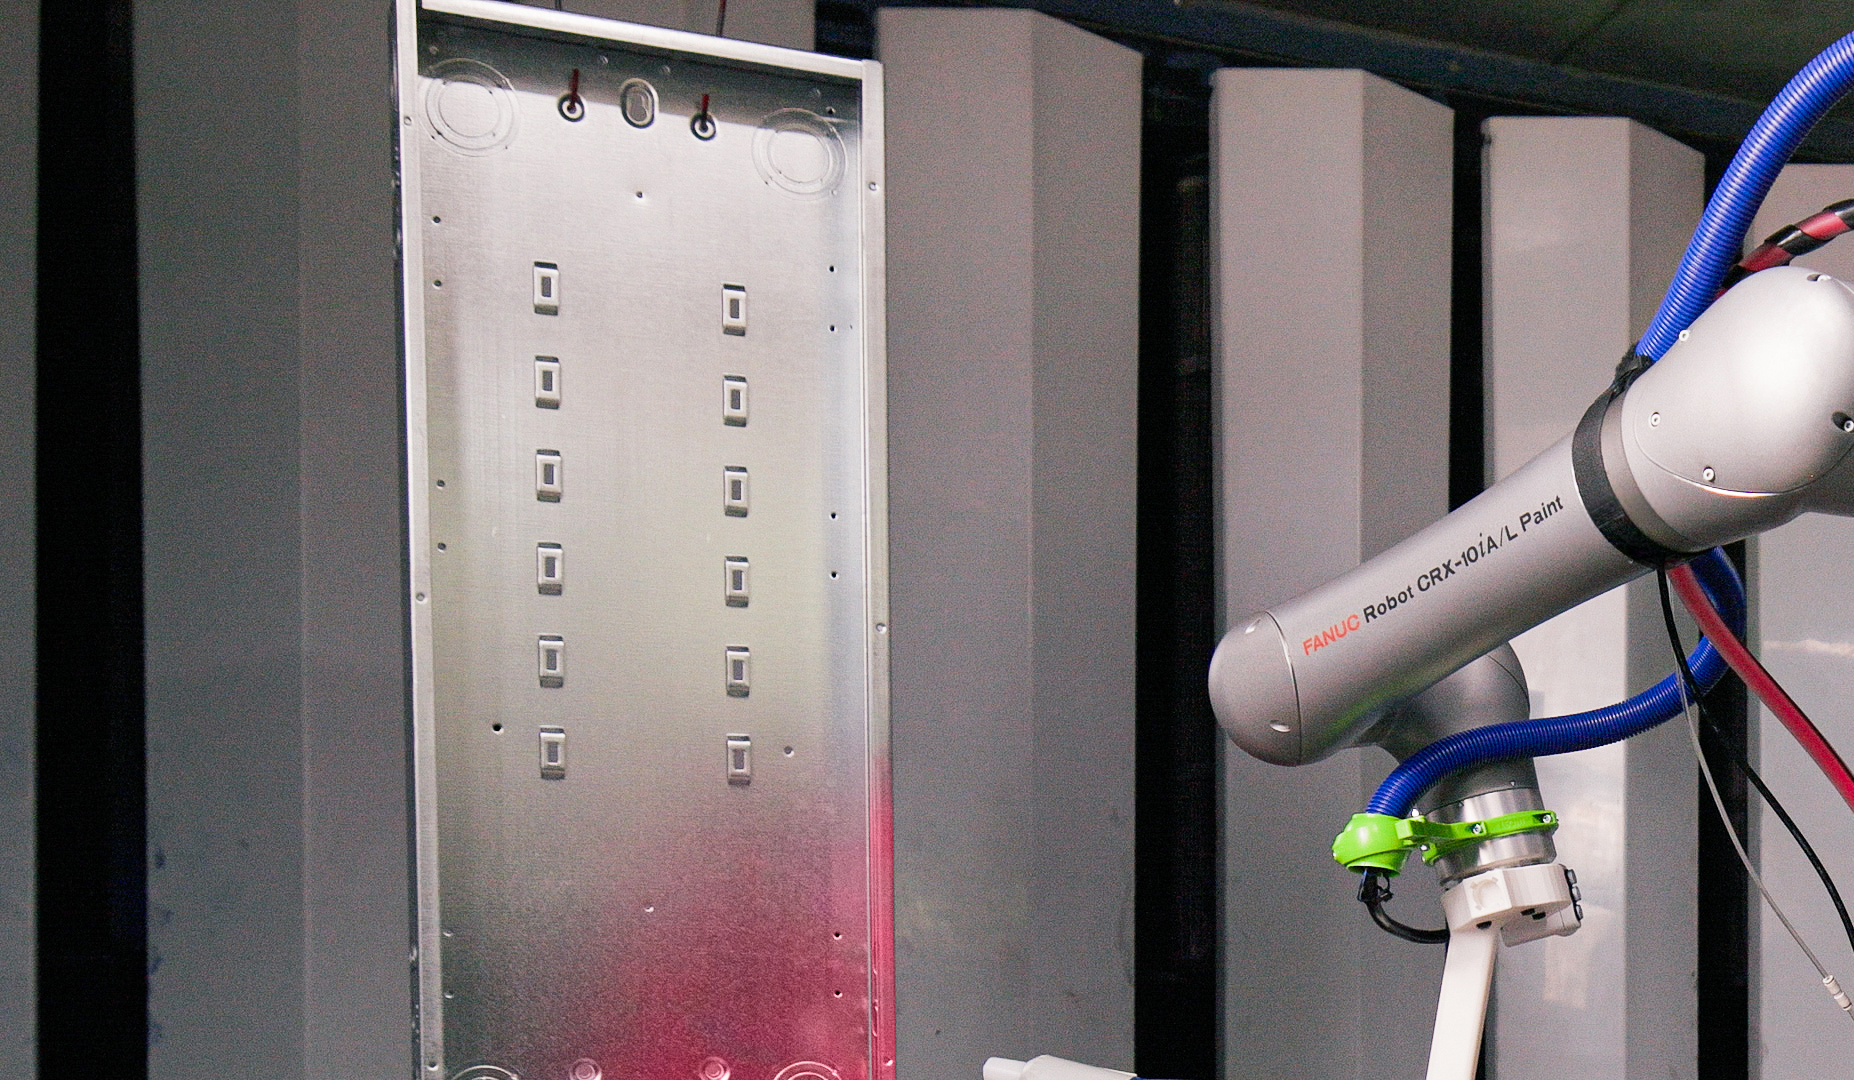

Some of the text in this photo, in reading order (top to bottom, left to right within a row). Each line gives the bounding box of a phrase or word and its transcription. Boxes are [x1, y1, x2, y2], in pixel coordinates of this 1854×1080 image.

[1302, 494, 1564, 656] FANUC Robot CRX-10iA/L Paint
